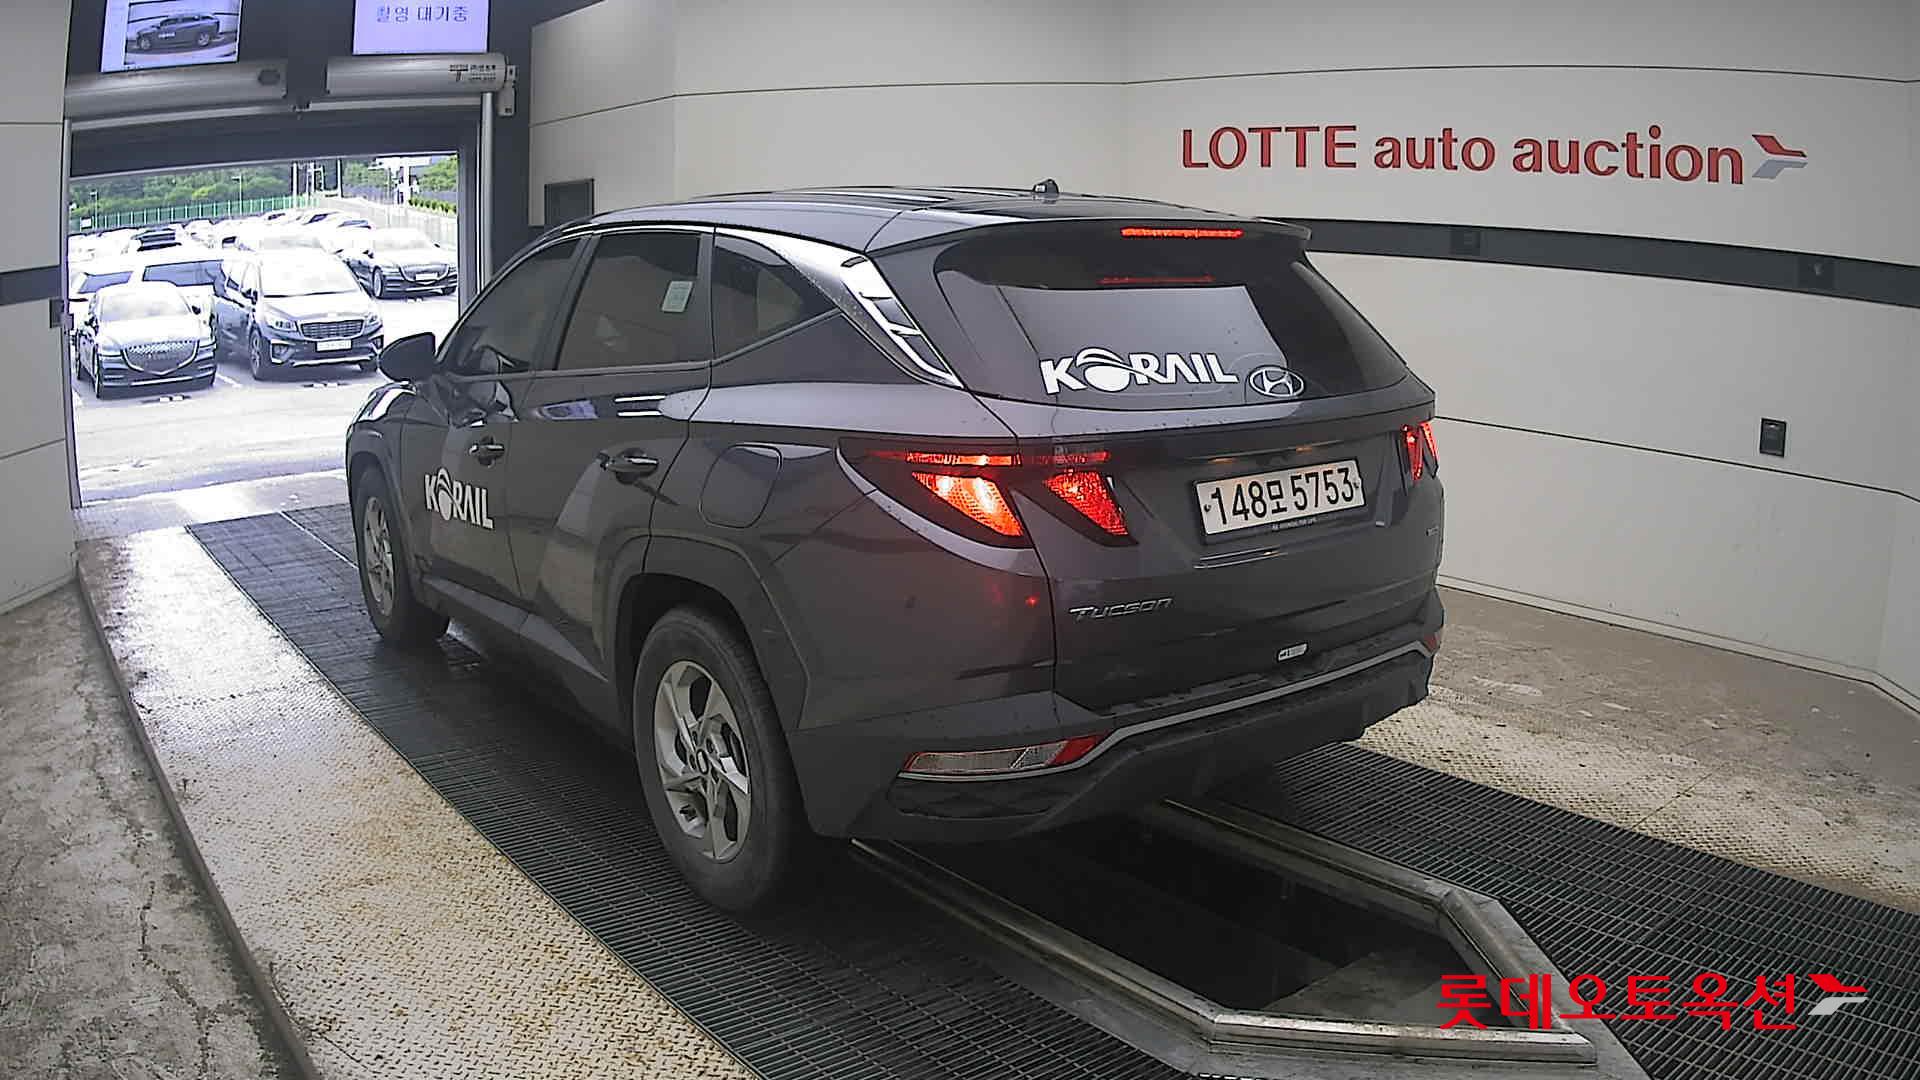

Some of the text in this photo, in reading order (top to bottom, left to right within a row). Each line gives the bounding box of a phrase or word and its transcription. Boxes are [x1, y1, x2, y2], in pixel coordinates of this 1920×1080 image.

[417, 6, 467, 22] 대기중
[1183, 125, 1744, 184] LOTTE auto auction
[1040, 347, 1238, 394] KORAIL
[424, 467, 494, 529] KORAIL
